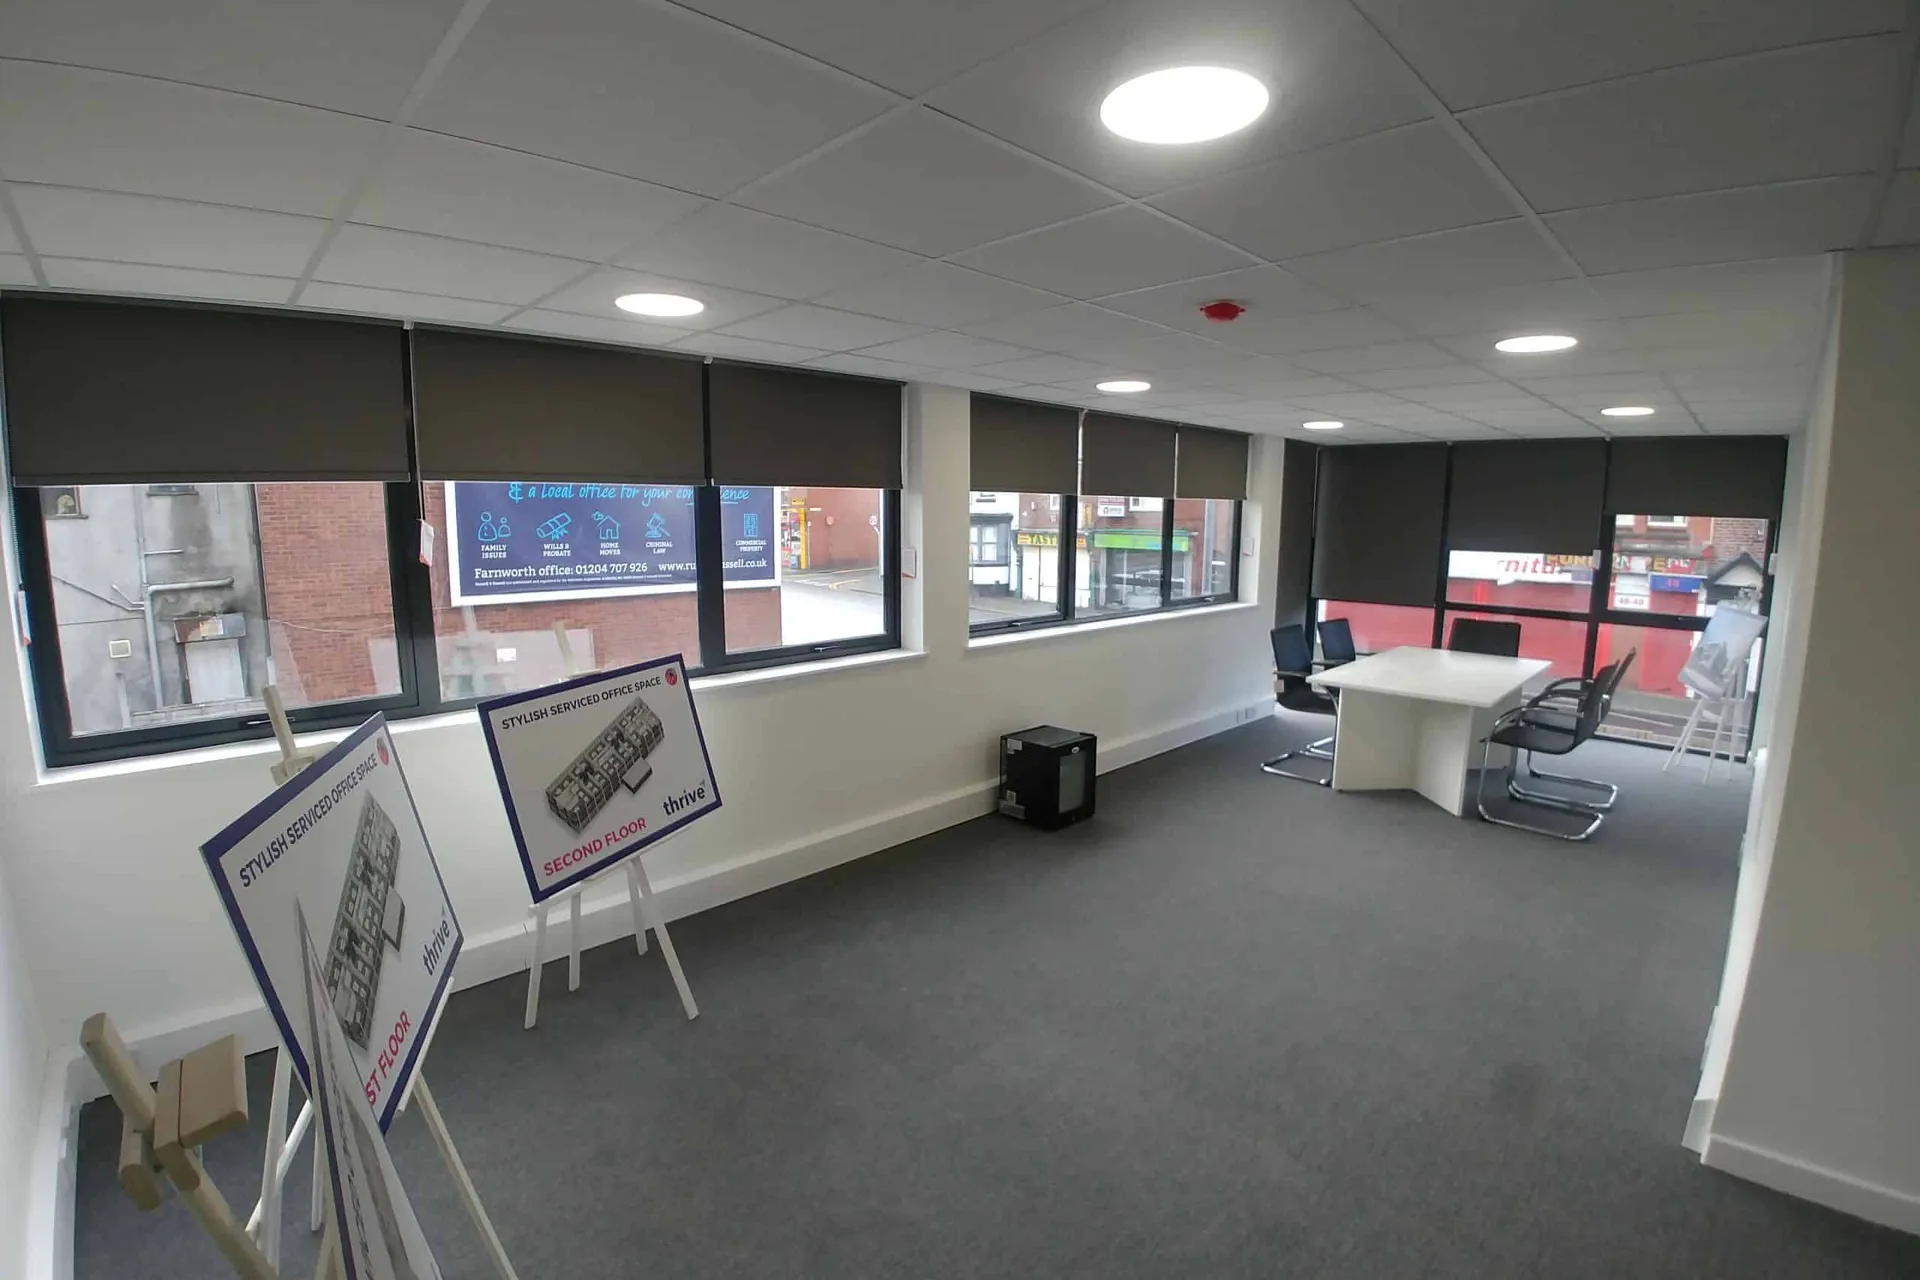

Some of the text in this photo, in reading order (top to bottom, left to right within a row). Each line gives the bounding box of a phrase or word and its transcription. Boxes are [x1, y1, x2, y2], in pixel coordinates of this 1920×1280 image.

[528, 486, 538, 498] a
[579, 483, 617, 499] office
[620, 484, 640, 500] for
[641, 487, 672, 507] your
[481, 544, 507, 552] FAMILY
[481, 551, 507, 559] ISSUES
[474, 566, 536, 579] Farnworth
[538, 565, 574, 576] office:
[575, 563, 608, 575] 01204
[610, 563, 628, 573] 707
[629, 562, 648, 572] 926
[502, 676, 661, 730] STYLISH SERVICED OFFICE SPACE
[239, 753, 378, 888] STYLISH SERVICED OFFICE SPACE
[662, 786, 706, 816] thrive
[544, 817, 648, 877] SECOND FLOOR
[422, 919, 450, 977] thrive
[378, 1010, 412, 1080] FLOOR
